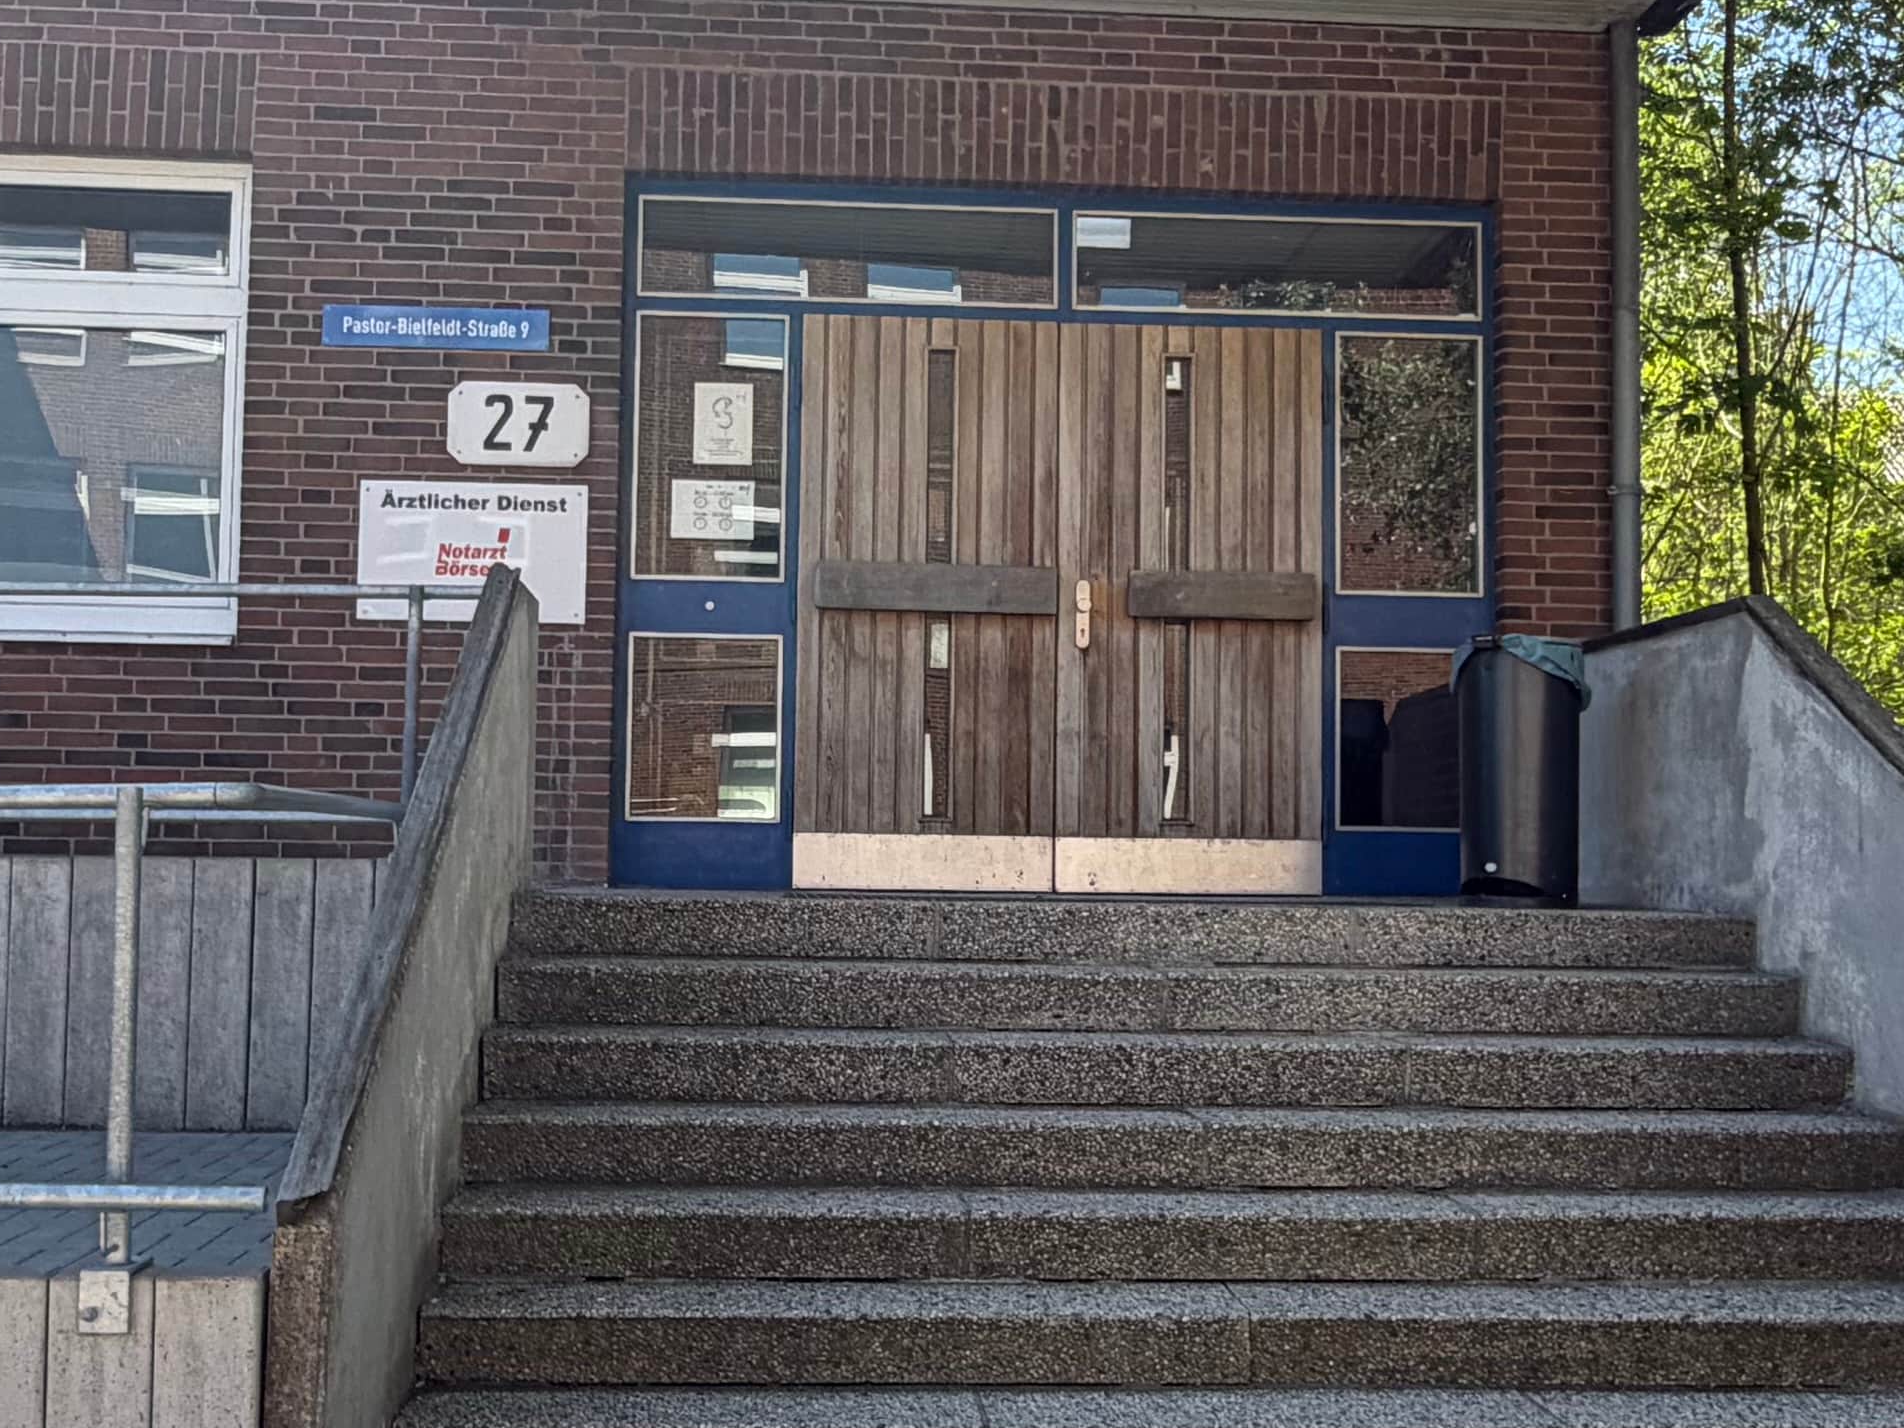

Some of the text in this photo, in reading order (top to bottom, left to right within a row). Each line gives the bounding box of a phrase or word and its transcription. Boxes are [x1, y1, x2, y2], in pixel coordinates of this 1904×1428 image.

[342, 315, 530, 339] Pastor-Bielfeldt-Straße 9
[483, 394, 554, 452] 27
[380, 489, 568, 513] Ärztlicher Dienst
[437, 543, 507, 560] Notarzt
[435, 559, 491, 577] Börse
